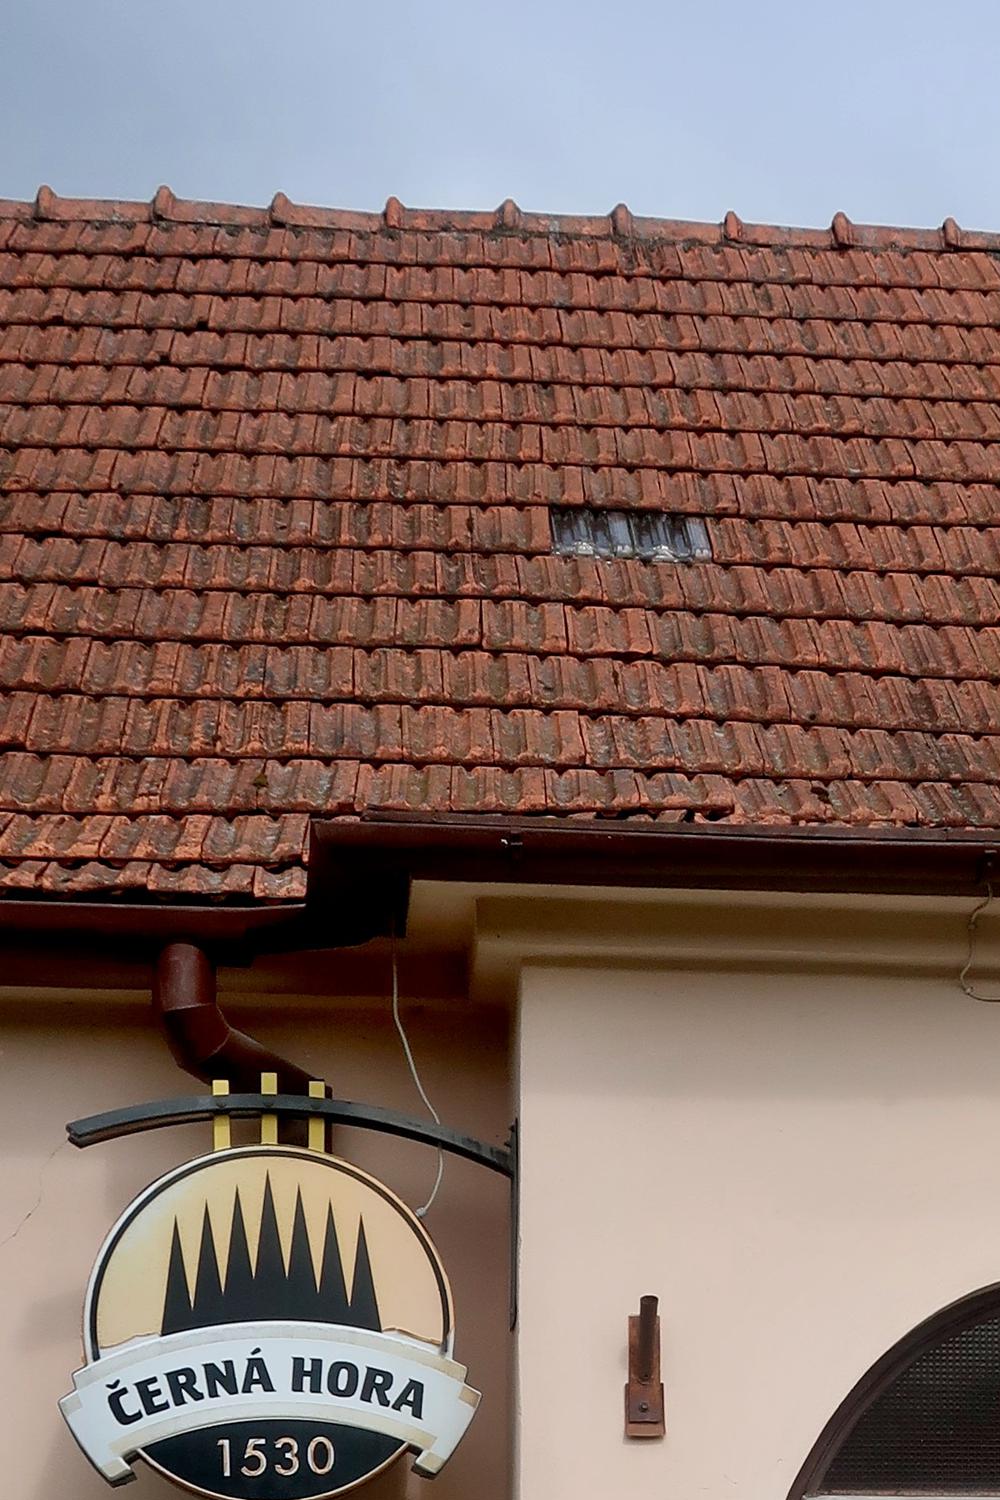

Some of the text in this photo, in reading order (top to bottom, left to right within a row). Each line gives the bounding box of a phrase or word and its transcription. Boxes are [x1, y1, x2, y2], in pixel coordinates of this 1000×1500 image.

[104, 1347, 425, 1426] ČERNÁ HORA
[217, 1436, 335, 1477] 1530
